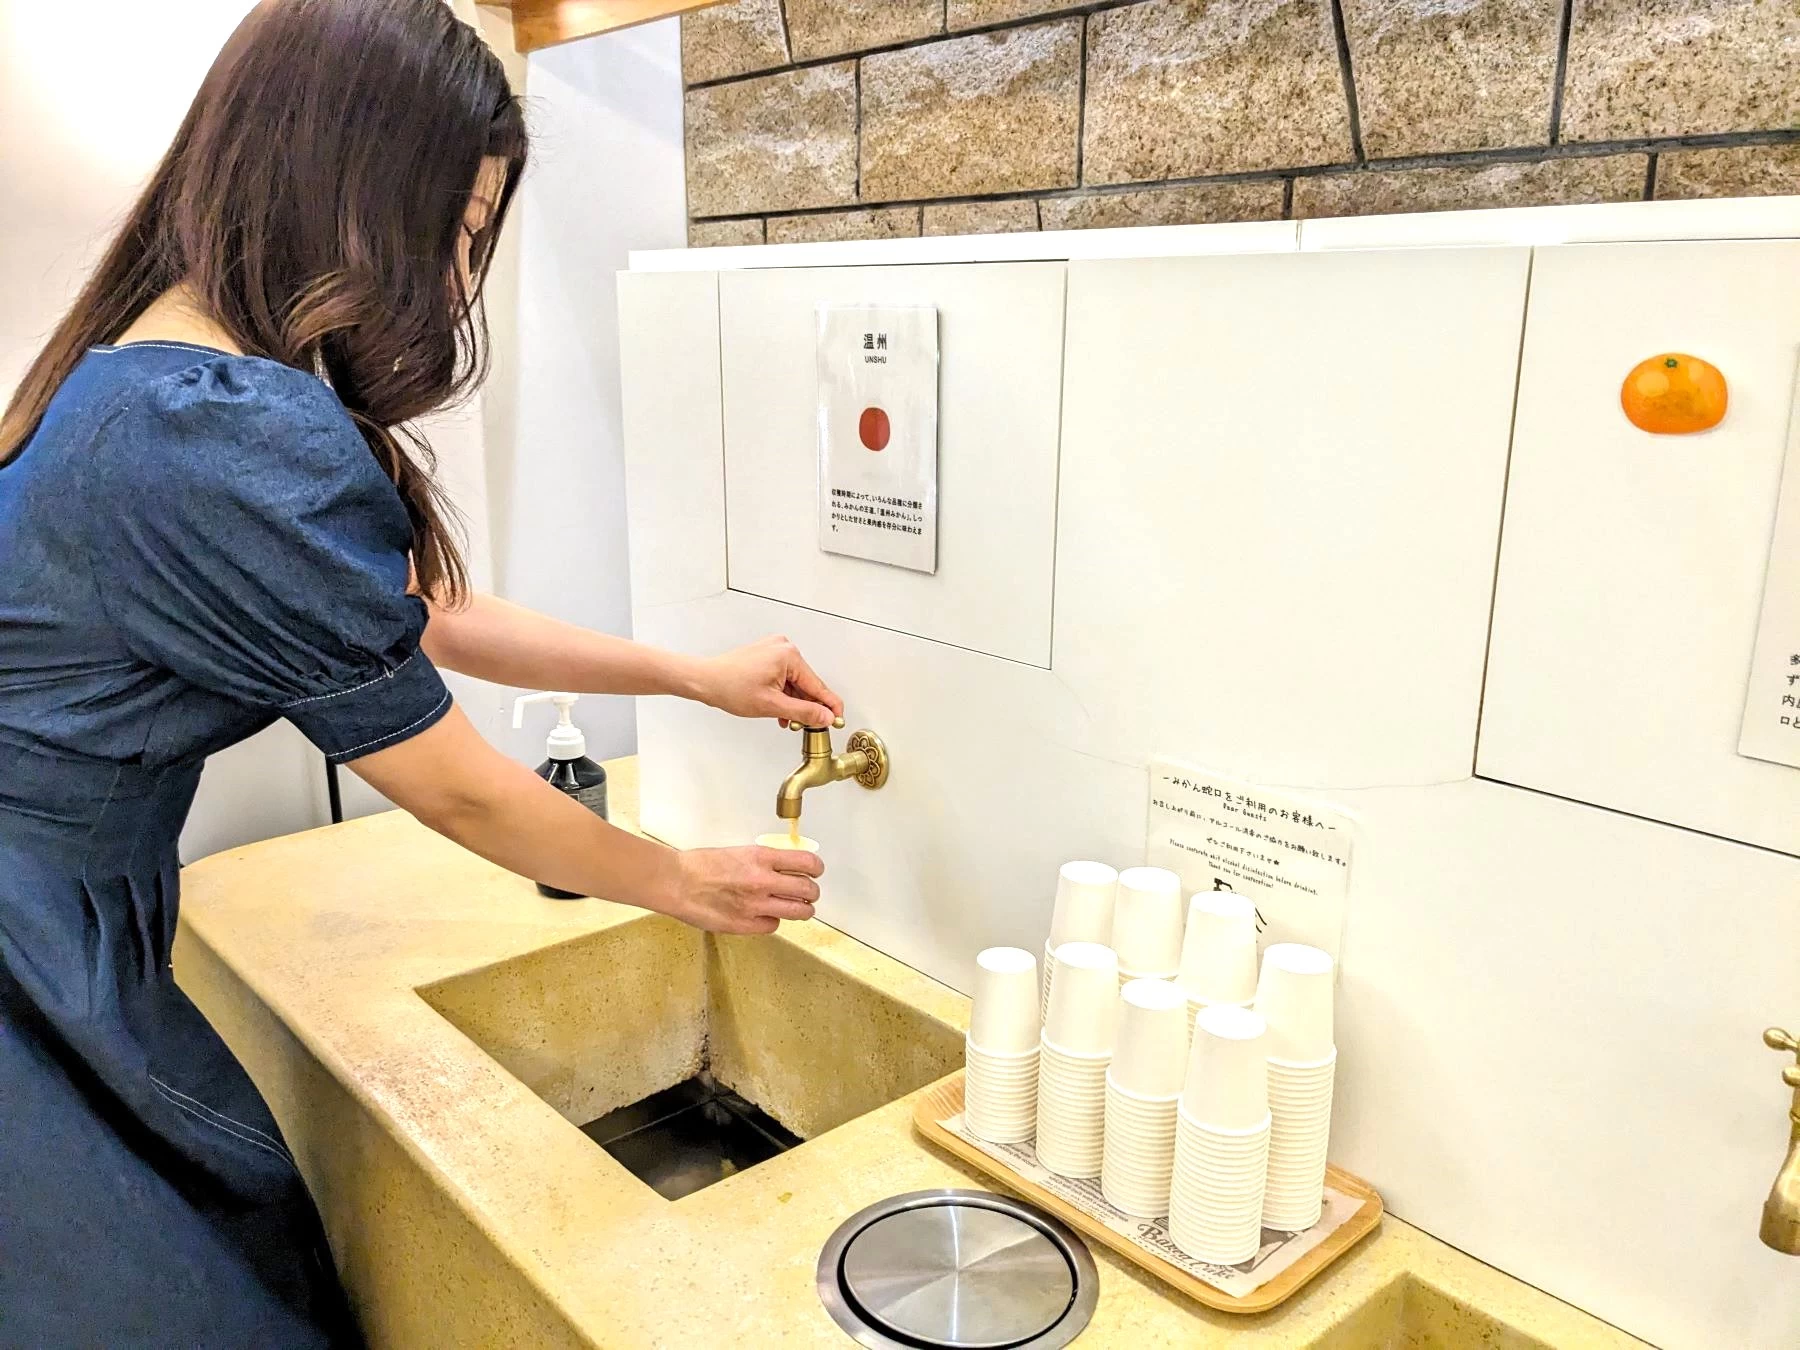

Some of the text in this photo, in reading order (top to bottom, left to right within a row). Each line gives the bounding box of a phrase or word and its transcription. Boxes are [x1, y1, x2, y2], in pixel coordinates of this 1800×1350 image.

[863, 333, 888, 351] 温州
[864, 355, 888, 364] UNSHU
[1222, 802, 1267, 822] Dear Guests
